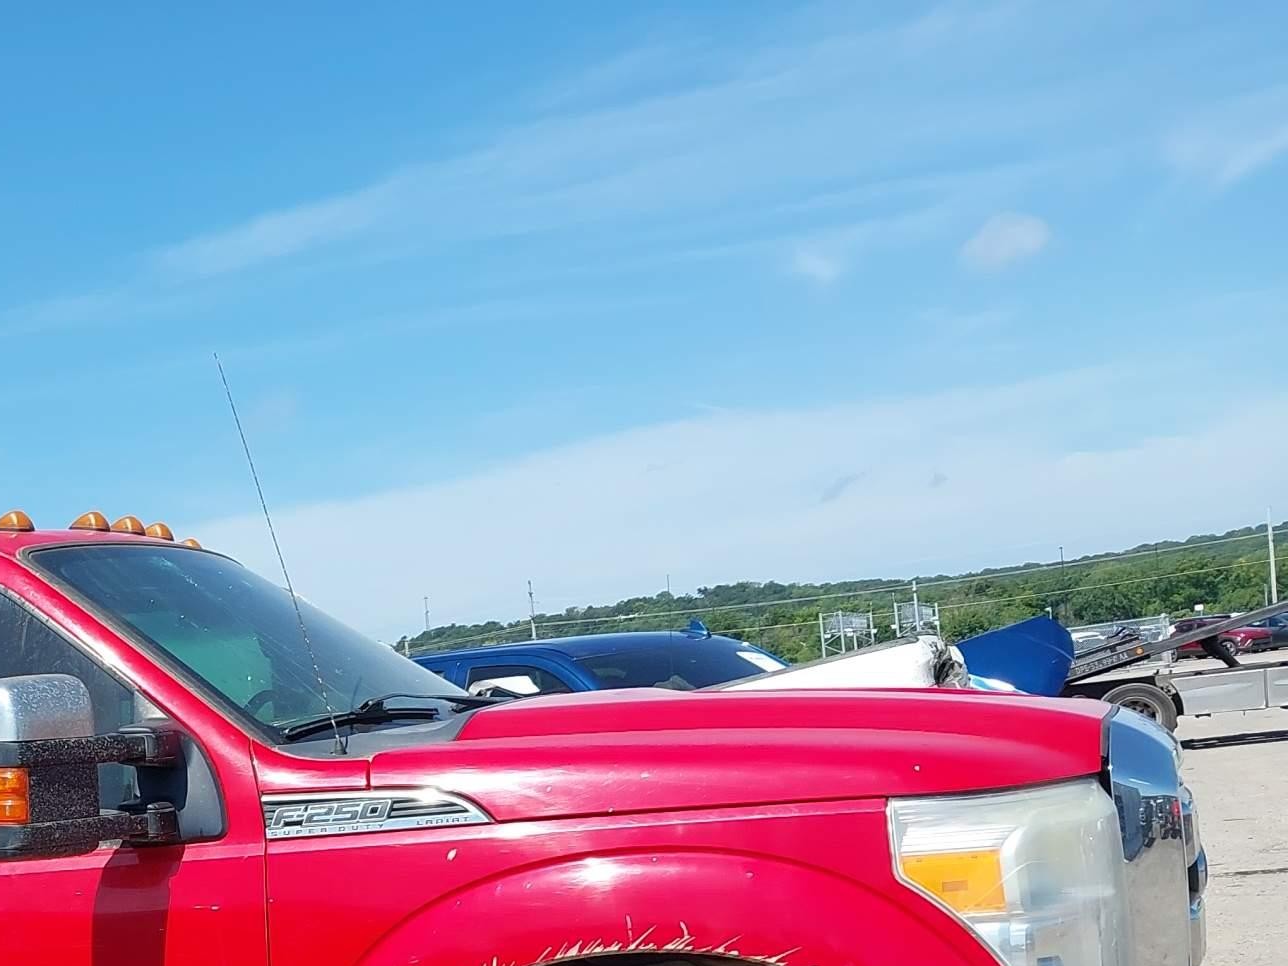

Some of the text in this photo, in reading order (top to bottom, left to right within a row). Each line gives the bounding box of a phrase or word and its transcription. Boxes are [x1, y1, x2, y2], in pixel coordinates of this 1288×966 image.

[270, 799, 391, 829] F-250
[416, 817, 469, 825] LARIAT
[271, 823, 383, 836] SUPER DUTY
